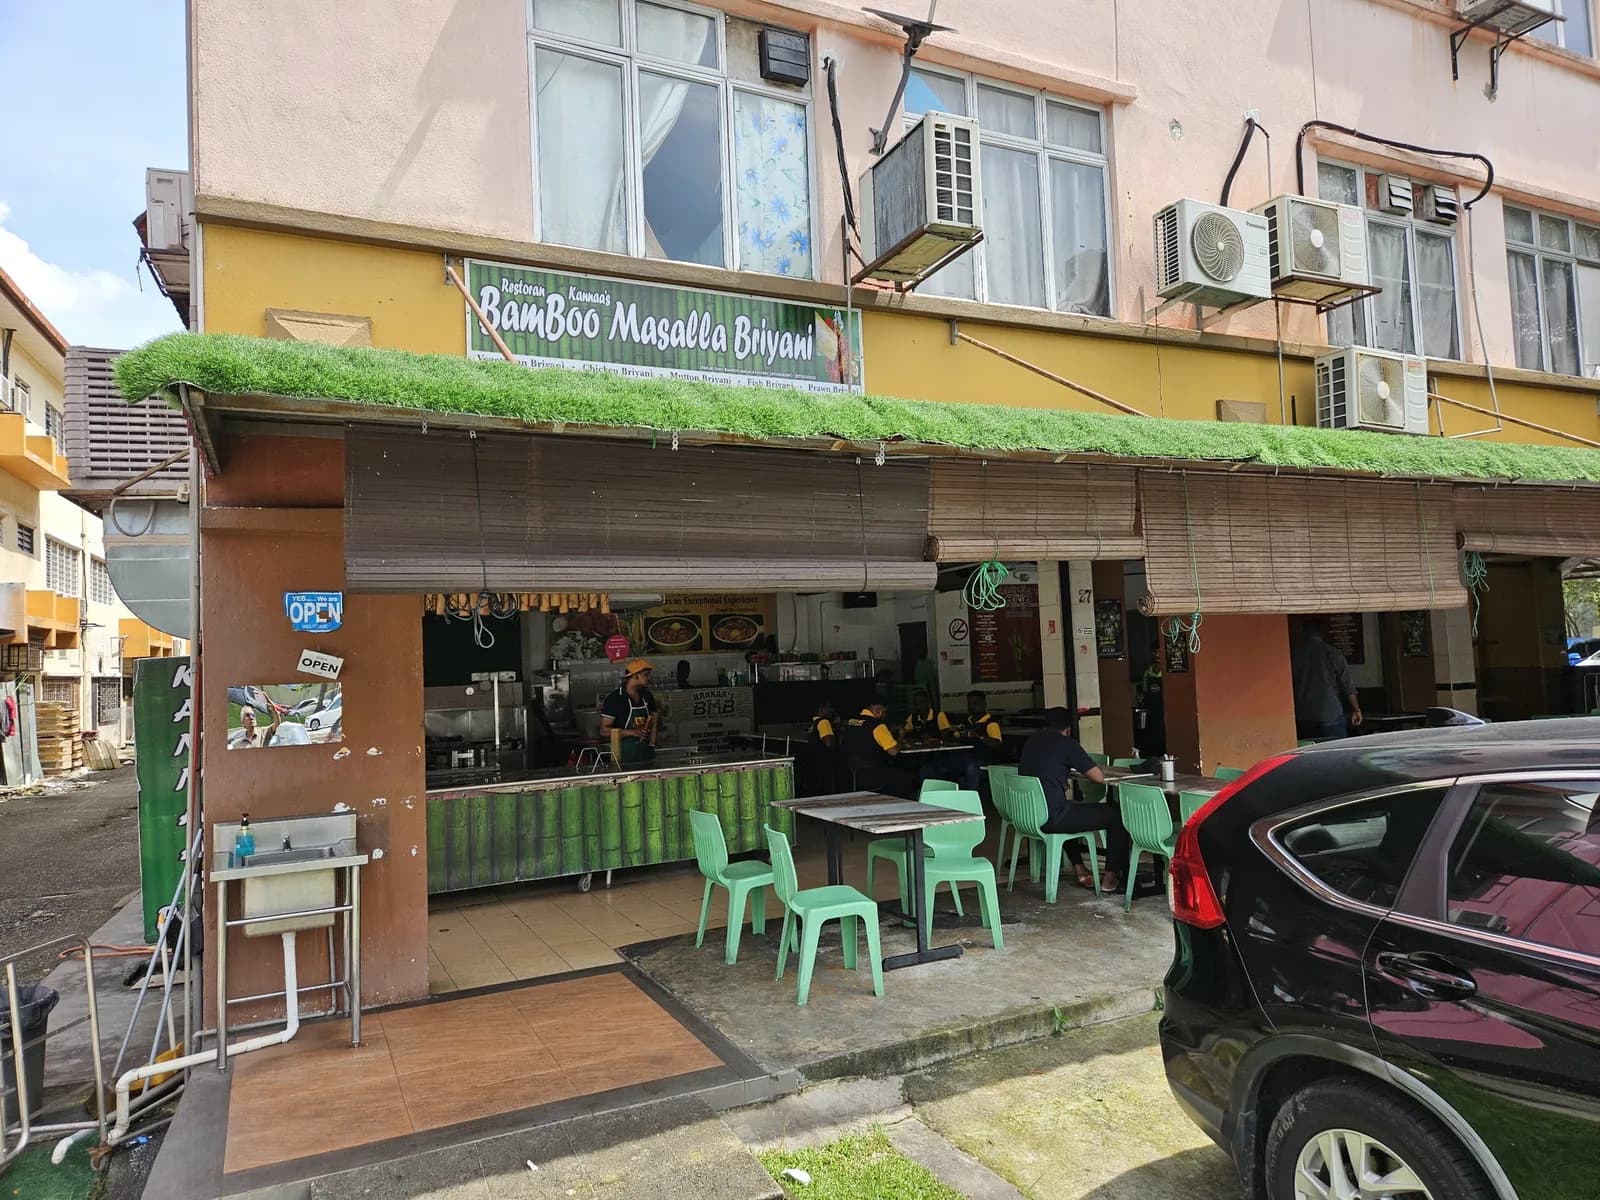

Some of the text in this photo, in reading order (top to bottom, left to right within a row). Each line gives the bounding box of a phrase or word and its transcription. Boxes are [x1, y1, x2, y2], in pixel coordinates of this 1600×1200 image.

[501, 277, 545, 298] Restoran
[568, 285, 611, 306] Kannaa's
[479, 285, 814, 365] BamBoo Masalla Briyani
[621, 367, 654, 377] Briyani
[702, 373, 731, 384] Briyani
[808, 383, 831, 393] Prawn
[1079, 589, 1092, 604] 27
[290, 602, 341, 624] OPEN
[302, 658, 338, 673] OPEN
[694, 700, 735, 715] BMB
